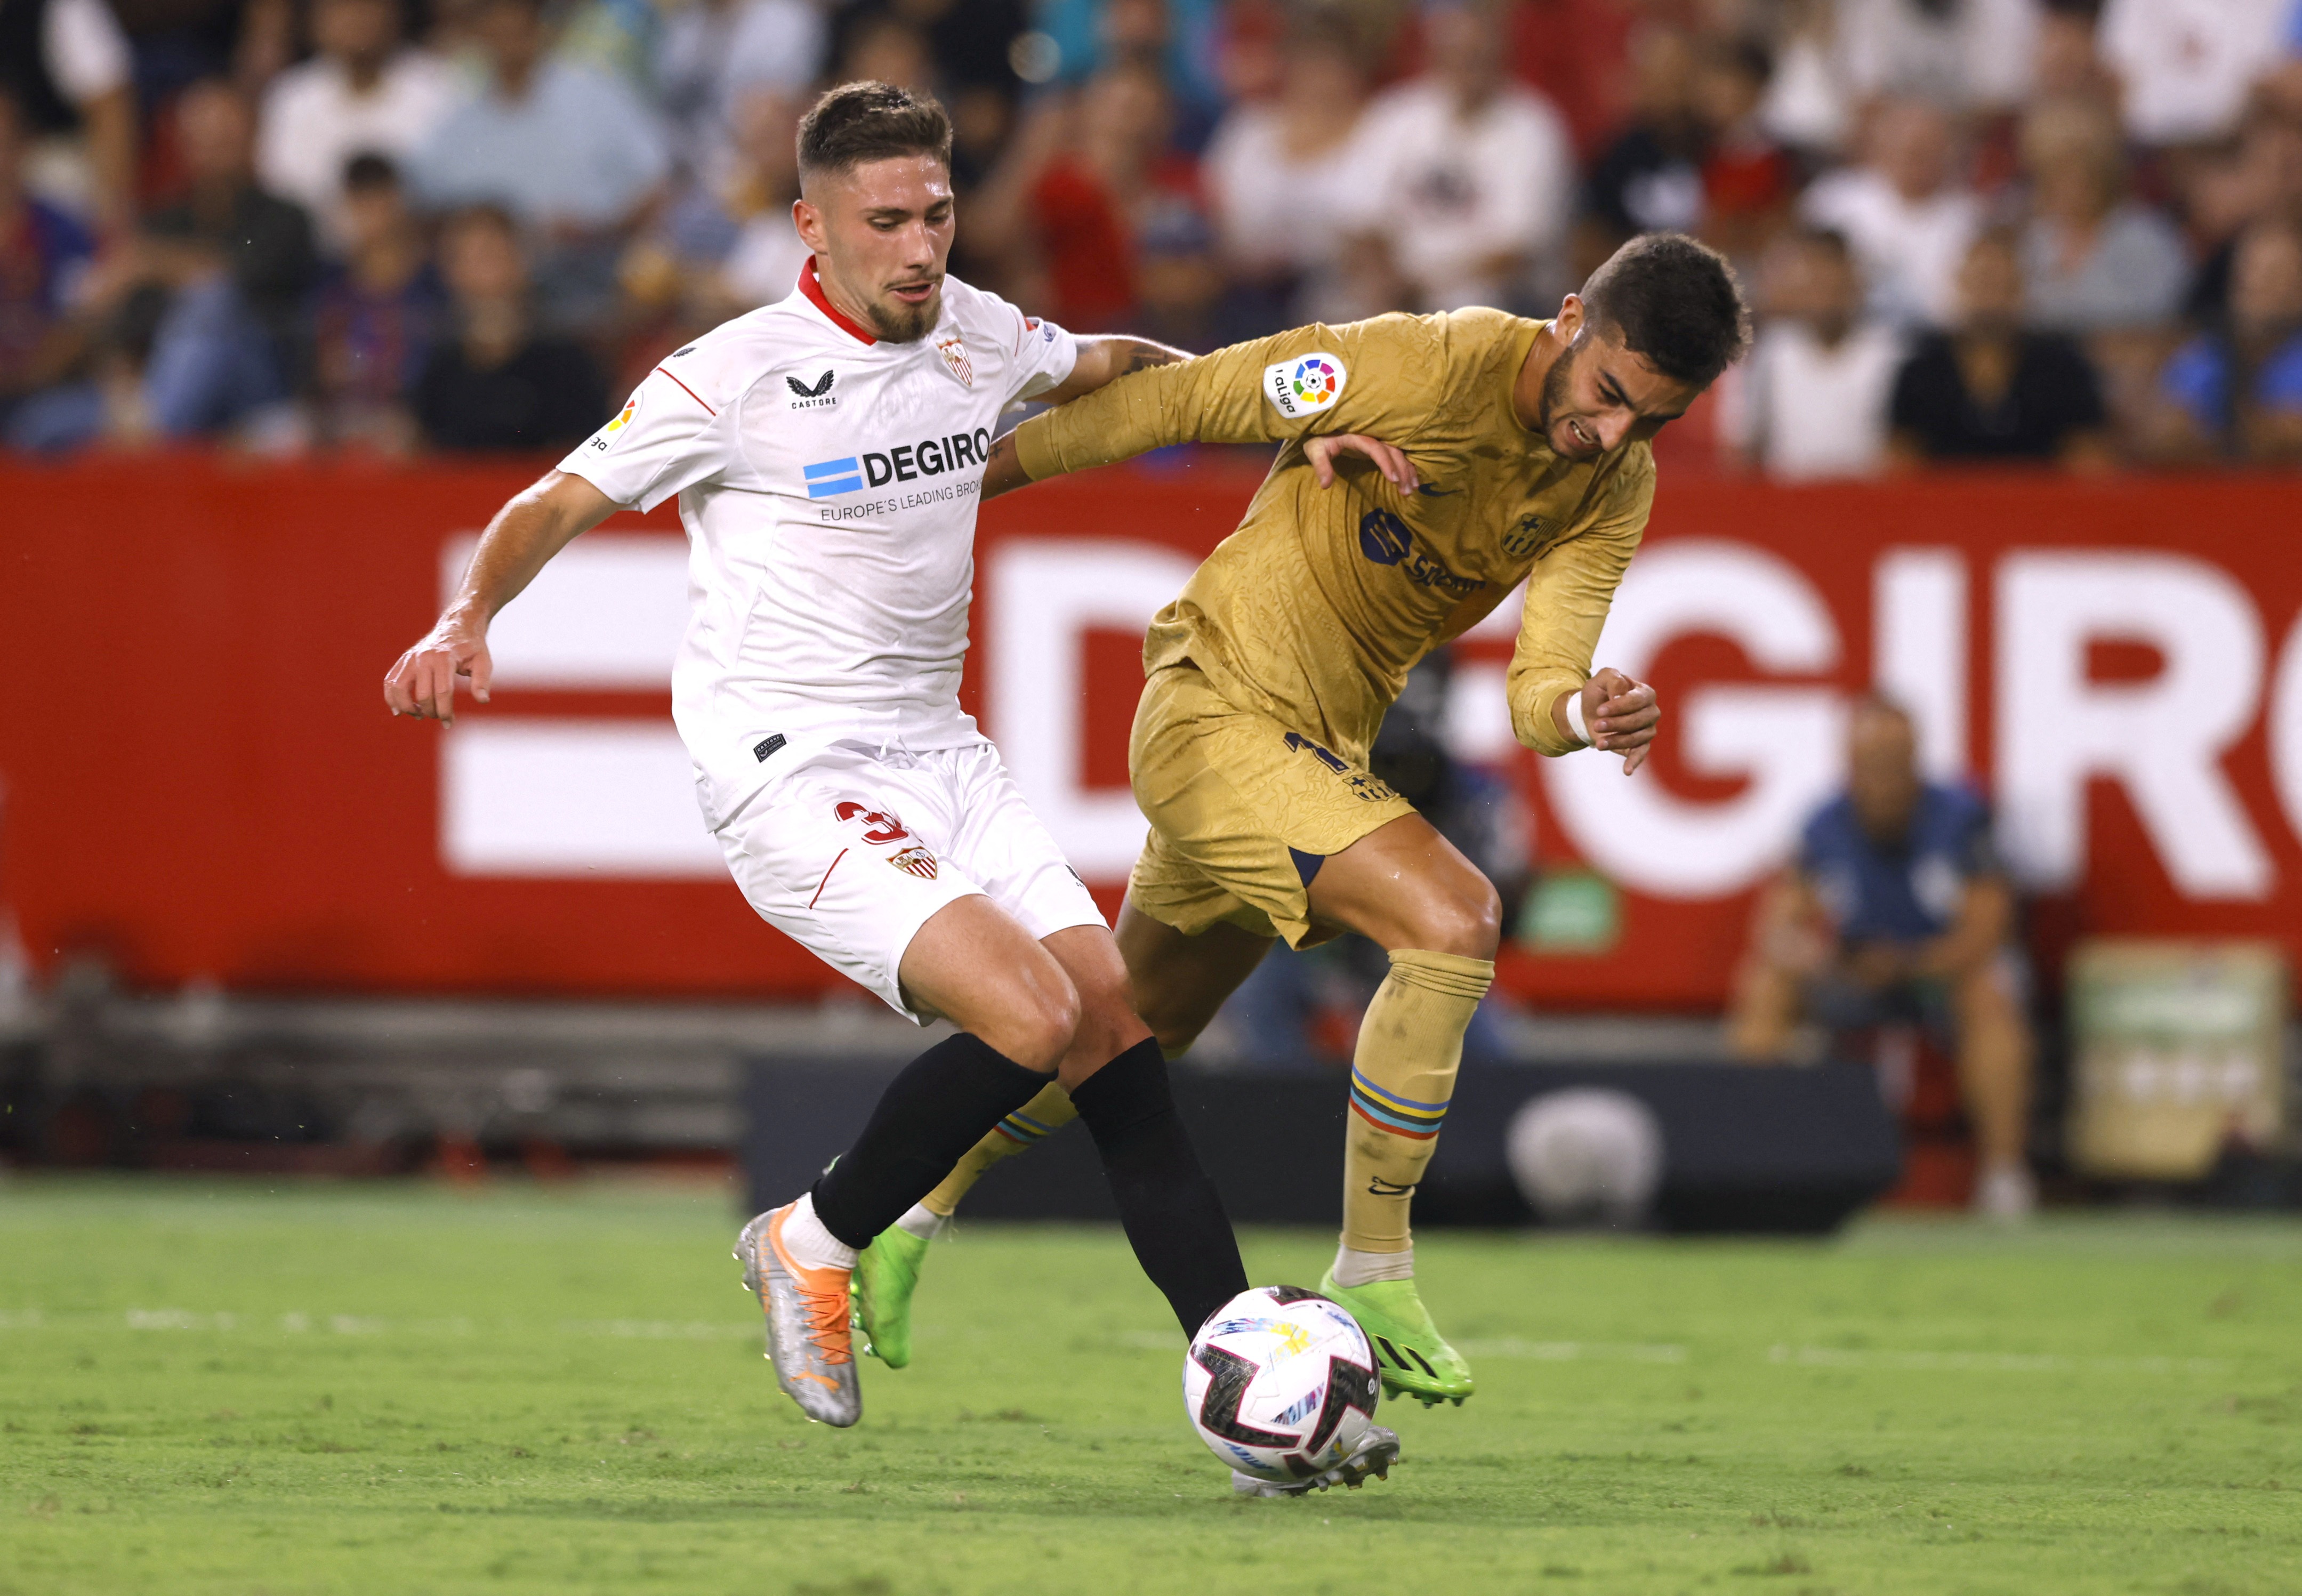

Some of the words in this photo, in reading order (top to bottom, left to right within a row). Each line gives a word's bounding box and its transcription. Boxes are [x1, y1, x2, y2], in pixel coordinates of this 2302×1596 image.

[792, 397, 837, 409] CASTORE
[863, 427, 991, 488] DEGIRO
[901, 487, 953, 509] LEADING
[757, 736, 780, 752] CASTORE
[834, 801, 909, 845] 3
